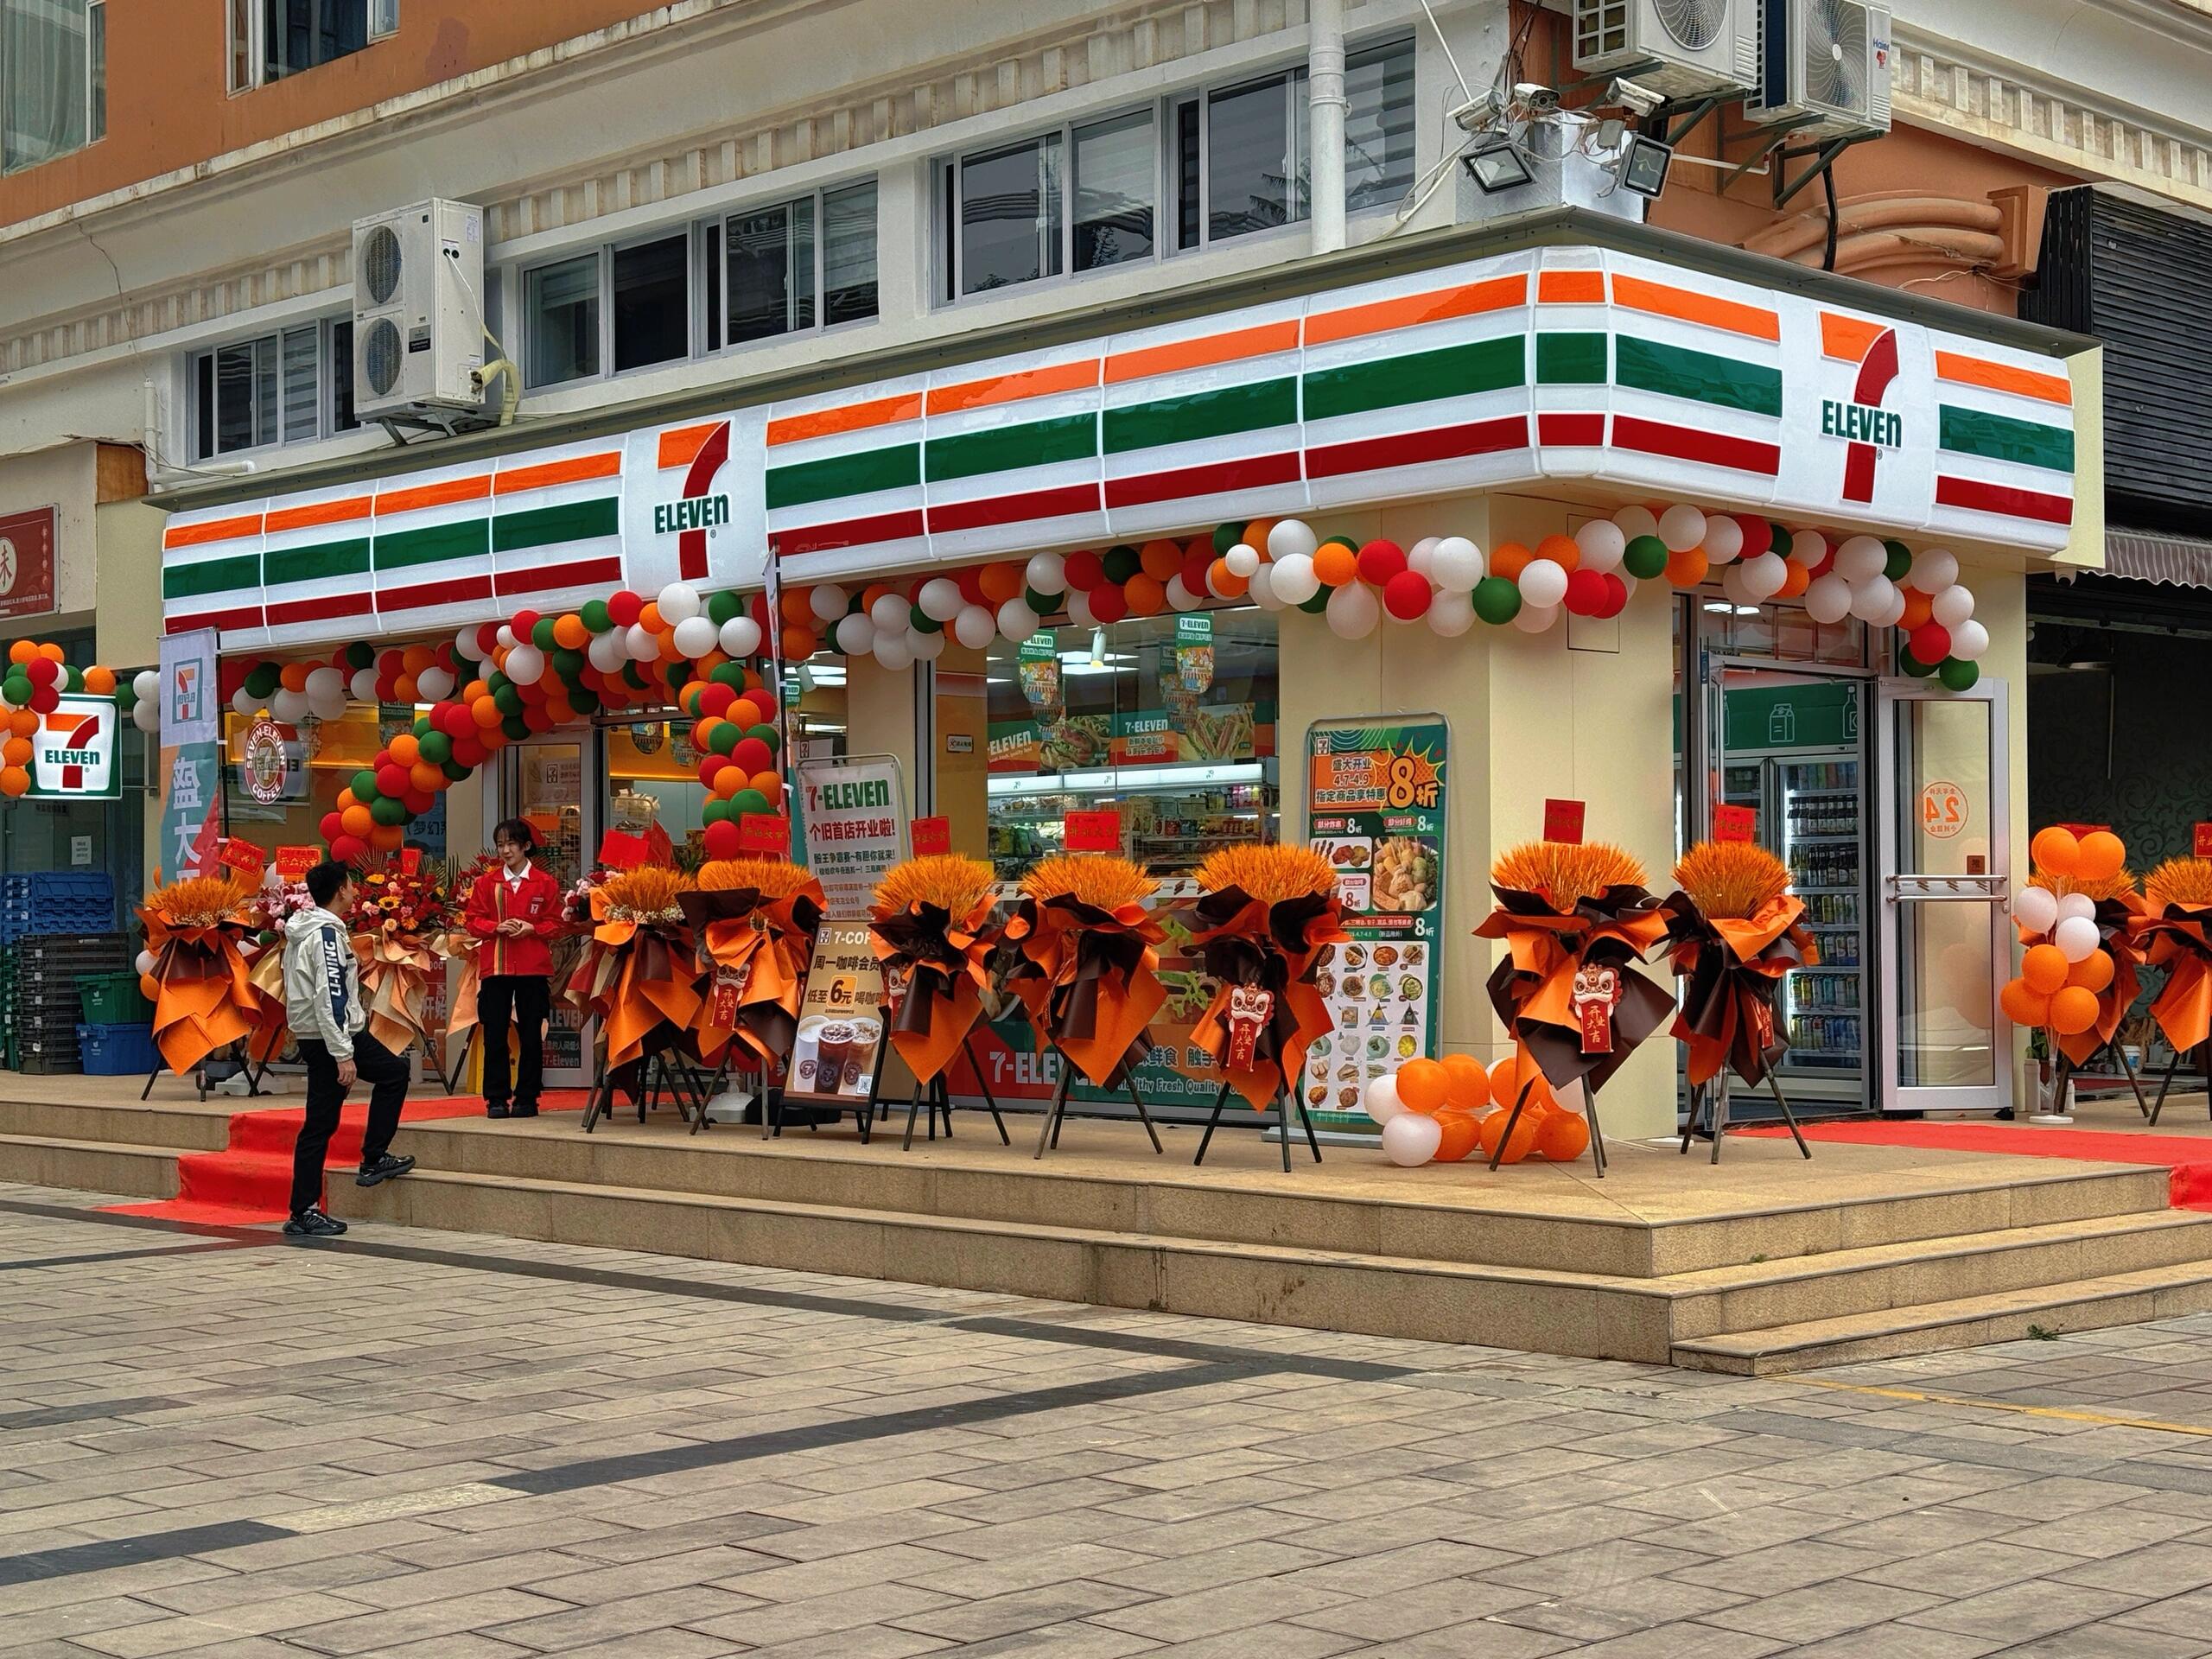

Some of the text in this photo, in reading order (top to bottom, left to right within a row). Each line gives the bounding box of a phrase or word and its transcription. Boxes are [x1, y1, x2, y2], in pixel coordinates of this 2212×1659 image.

[1872, 37, 1891, 52] Haier
[1819, 310, 1899, 504] 7
[658, 420, 731, 581] 7
[46, 714, 99, 788] 7
[1332, 758, 1372, 772] 盛大开业
[1333, 773, 1370, 787] 4.7-4.9
[1389, 756, 1440, 809] 8折
[251, 781, 281, 801] COFFEE
[1316, 788, 1387, 804] 指定商品享特惠
[324, 940, 342, 997] LI-NING
[1156, 1077, 1184, 1093] Fresh
[1185, 1079, 1222, 1096] Quality
